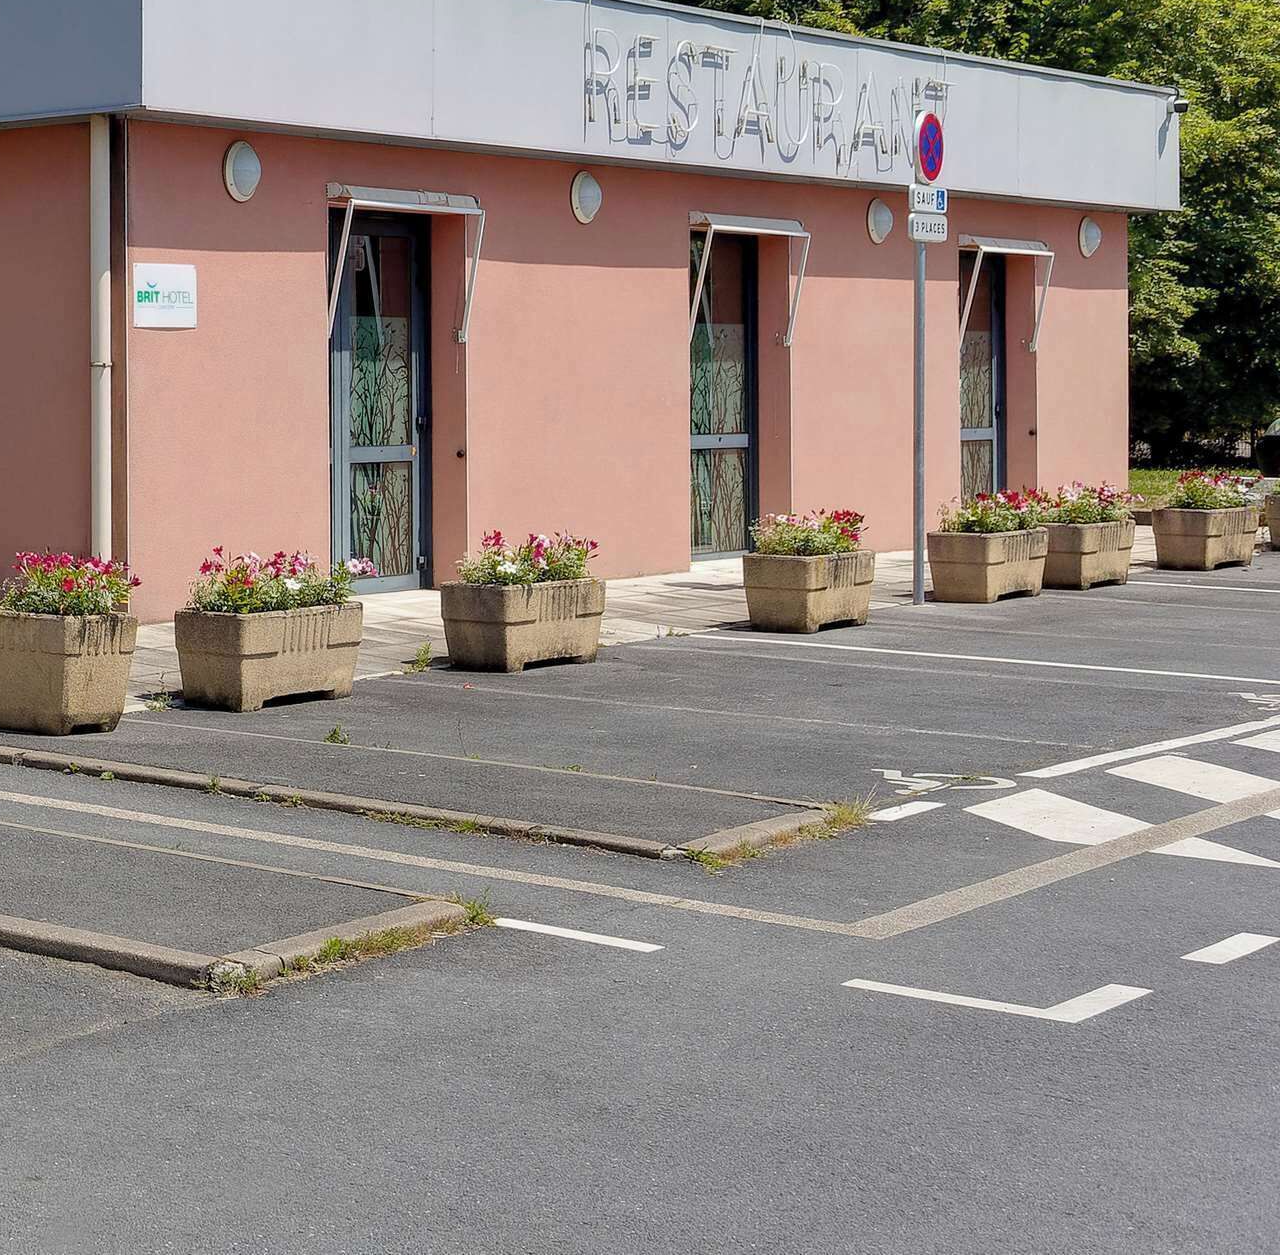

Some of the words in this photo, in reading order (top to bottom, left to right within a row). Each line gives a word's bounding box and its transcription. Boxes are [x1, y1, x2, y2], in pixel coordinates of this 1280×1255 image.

[917, 191, 935, 205] SAUF
[915, 221, 920, 232] 3
[921, 221, 945, 234] PLACES
[137, 290, 160, 303] BRIT
[162, 290, 193, 304] HOTEL
